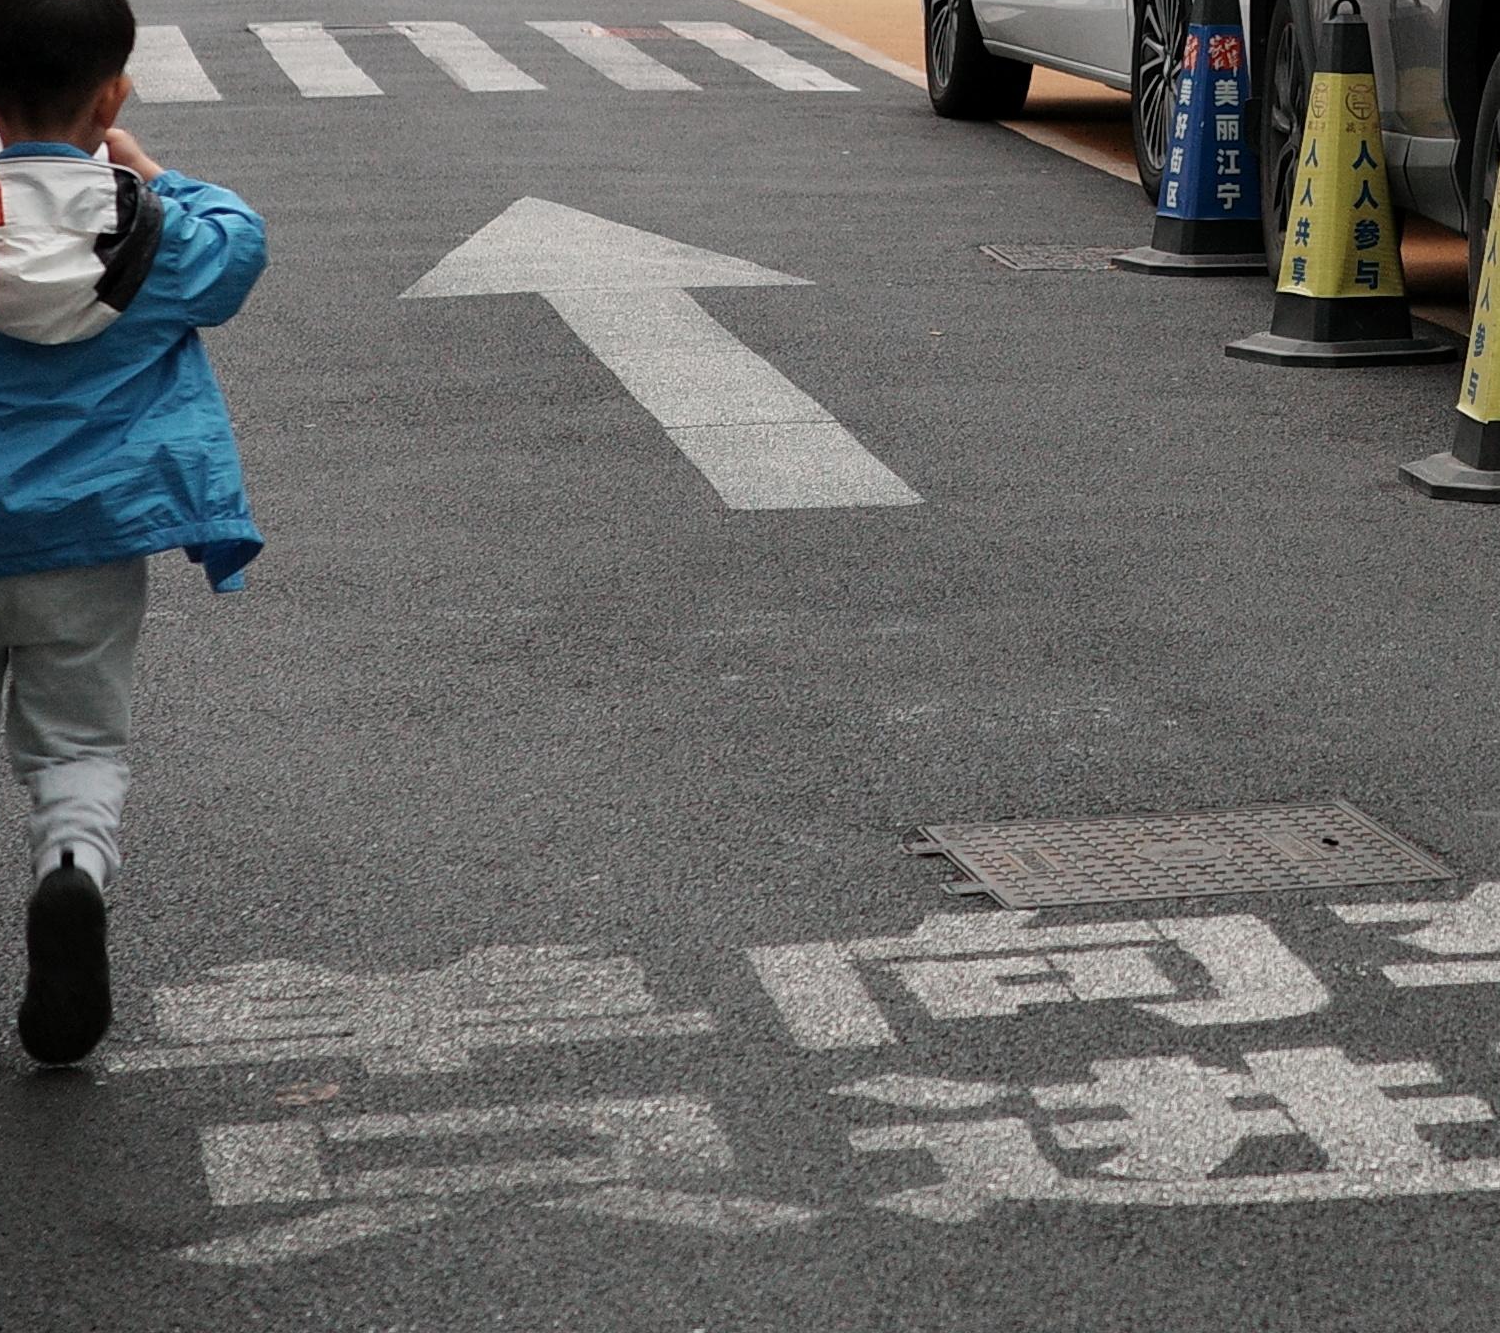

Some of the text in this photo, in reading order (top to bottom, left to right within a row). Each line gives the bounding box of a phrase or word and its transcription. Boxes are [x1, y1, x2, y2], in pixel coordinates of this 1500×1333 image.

[1166, 78, 1193, 208] 美好街区
[1214, 79, 1241, 210] 美丽江宁
[1292, 138, 1319, 287] 人人共享
[1352, 140, 1381, 290] 人人参与
[1467, 230, 1498, 405] 人人参与
